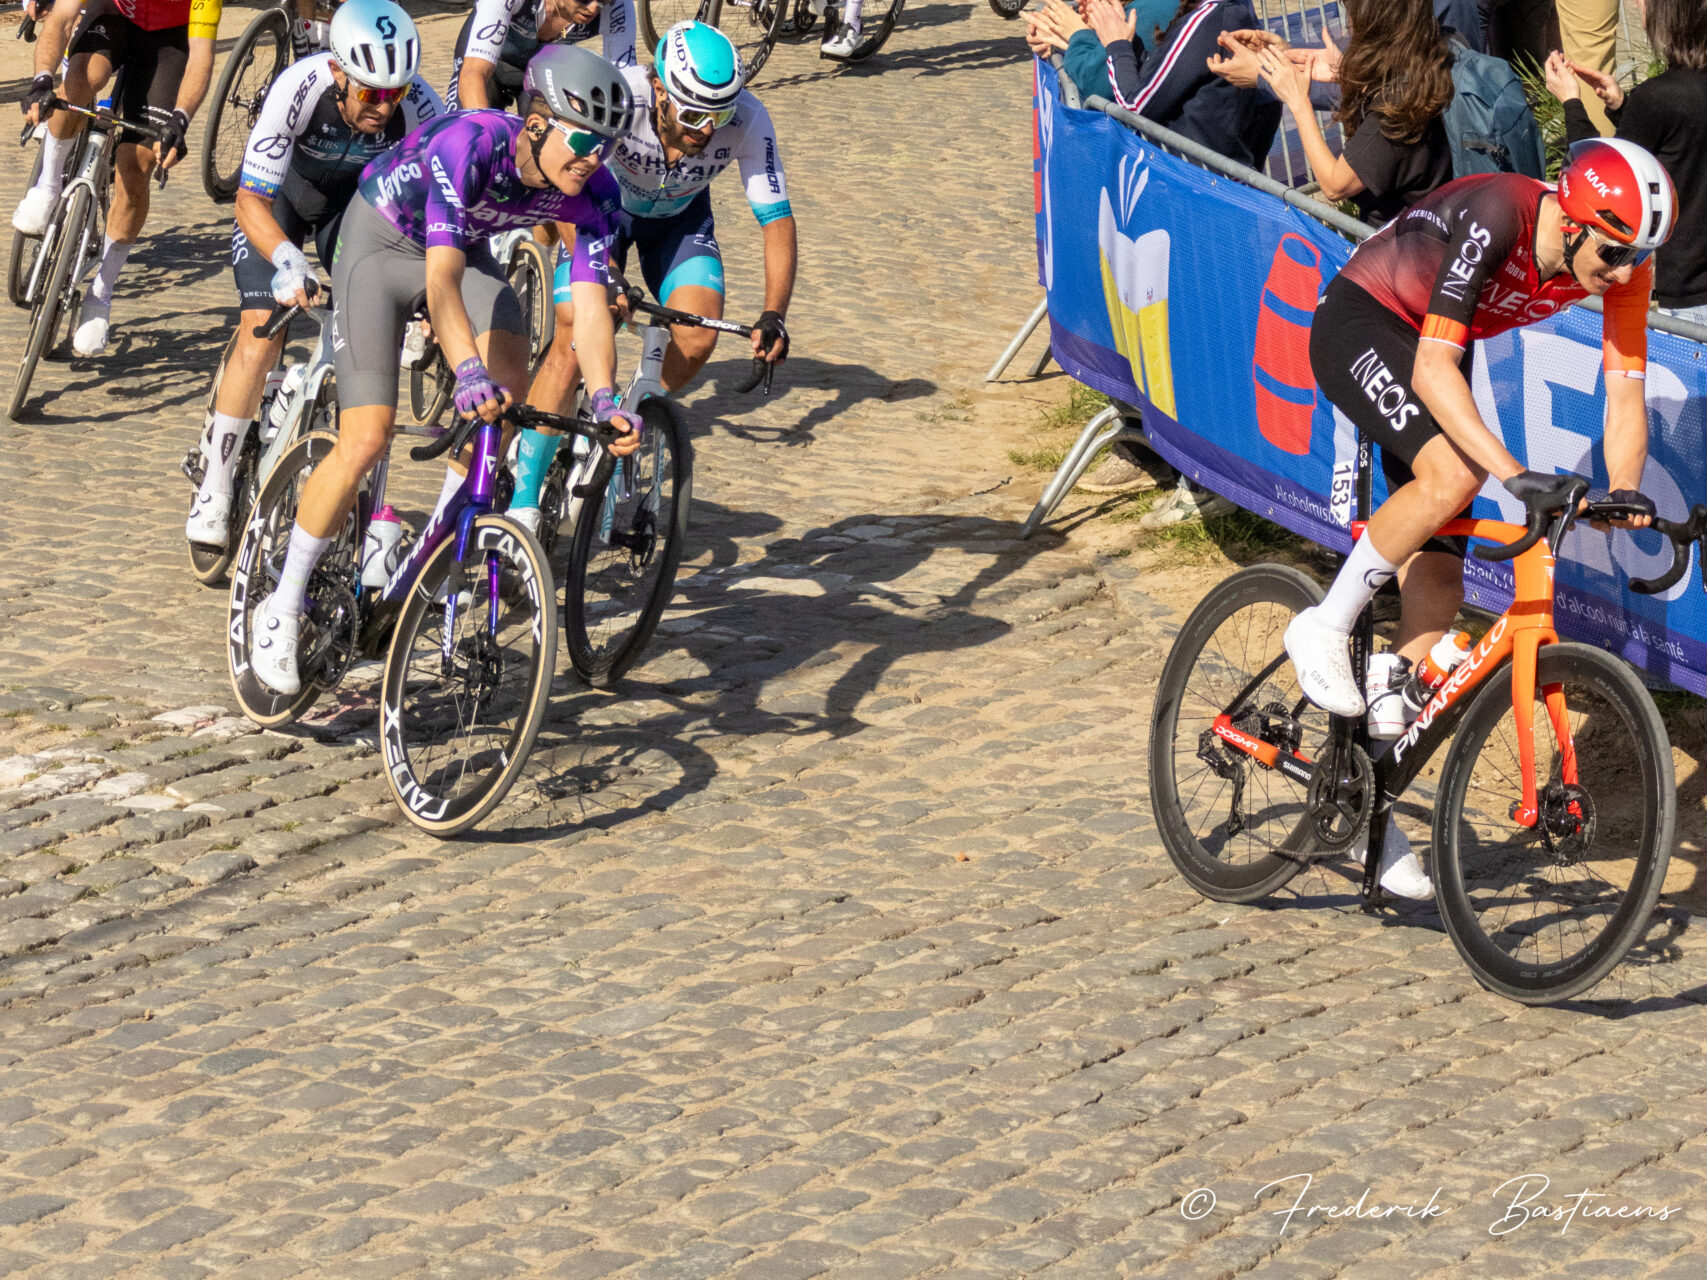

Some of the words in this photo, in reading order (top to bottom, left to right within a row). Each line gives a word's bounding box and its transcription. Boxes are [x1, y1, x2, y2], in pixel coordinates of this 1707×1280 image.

[608, 3, 626, 34] UBS
[673, 29, 689, 72] RUDY
[285, 69, 318, 131] Q36.5
[317, 138, 340, 151] UBS
[763, 136, 782, 195] MERIDA
[376, 161, 423, 208] Jayco
[1583, 167, 1612, 199] KASK
[1440, 221, 1492, 303] INEOS
[1504, 260, 1528, 282] GOBIK
[1349, 347, 1420, 432] INEOS
[1330, 465, 1353, 508] 153
[382, 504, 445, 602] GIANT
[229, 503, 266, 676] CADEX
[477, 526, 542, 645] CADEX
[442, 602, 453, 658] GIANT
[1556, 592, 1607, 624] d'alcool
[1607, 614, 1631, 634] nuit
[1639, 626, 1651, 645] la
[1651, 634, 1690, 664] santé.
[1309, 669, 1331, 692] GOBIK
[1393, 616, 1508, 765] PINARELLO
[384, 700, 451, 821] CADEX
[1214, 723, 1260, 753] DOGMA
[1282, 760, 1313, 782] SHIMANO
